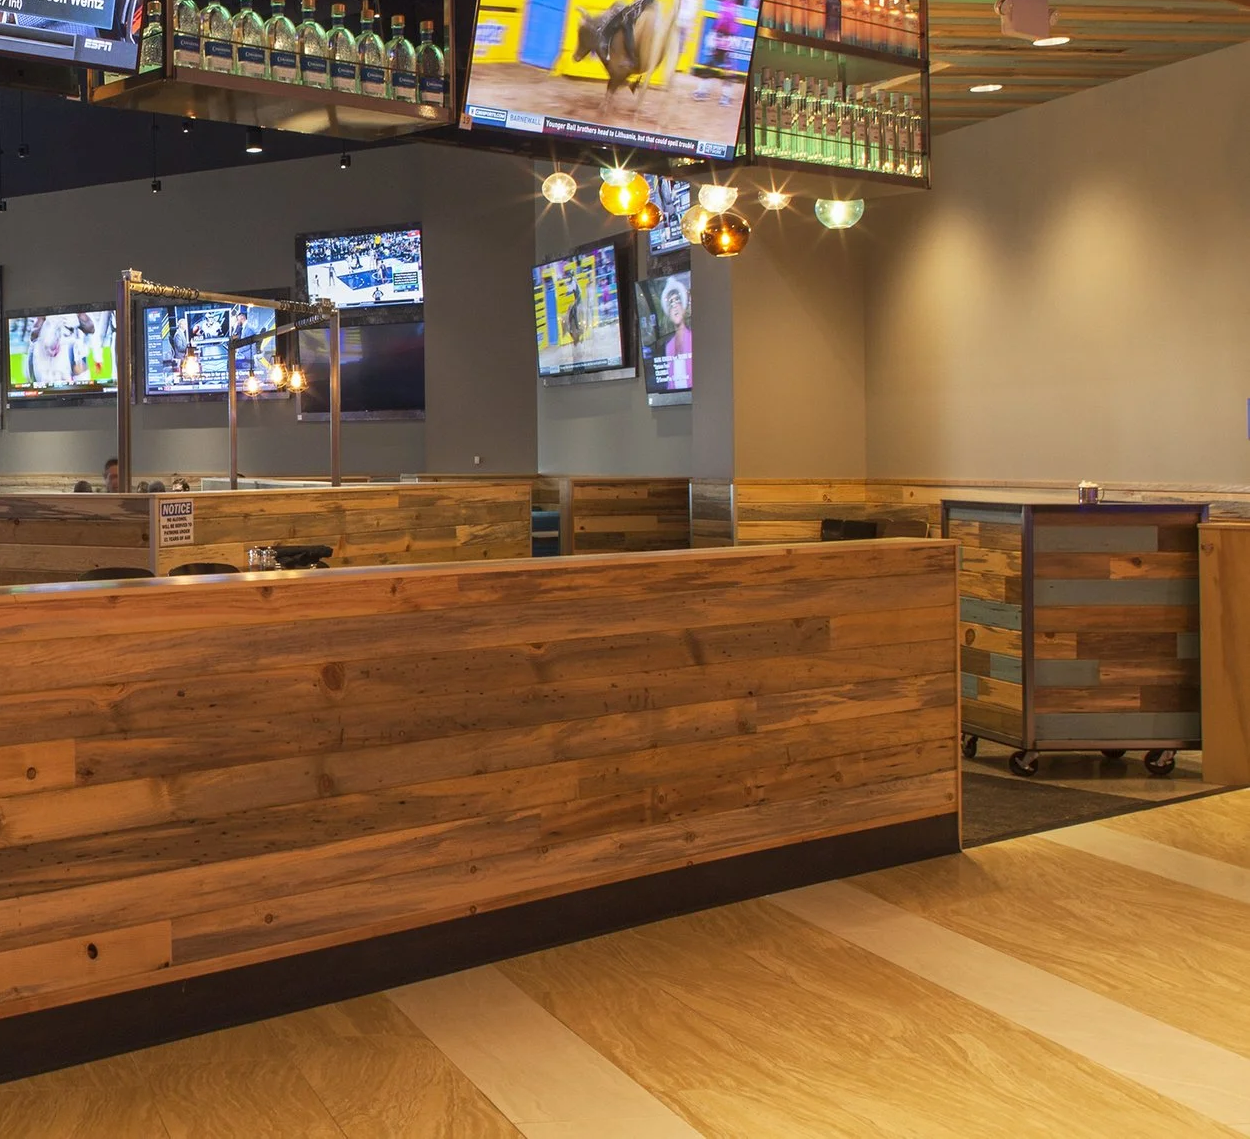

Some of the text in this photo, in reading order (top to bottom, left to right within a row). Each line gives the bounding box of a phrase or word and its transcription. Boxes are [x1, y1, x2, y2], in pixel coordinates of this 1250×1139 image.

[84, 38, 112, 52] ESPN
[462, 115, 470, 125] 19
[545, 119, 566, 131] Younger
[566, 122, 576, 132] Ball
[576, 124, 597, 135] brothers
[597, 127, 609, 137] head
[614, 131, 637, 142] Lithuania,
[637, 134, 645, 142] but
[646, 135, 654, 143] that
[654, 136, 667, 146] could
[667, 138, 678, 148] spell
[678, 140, 695, 150] trouble
[162, 502, 191, 516] NOTICE
